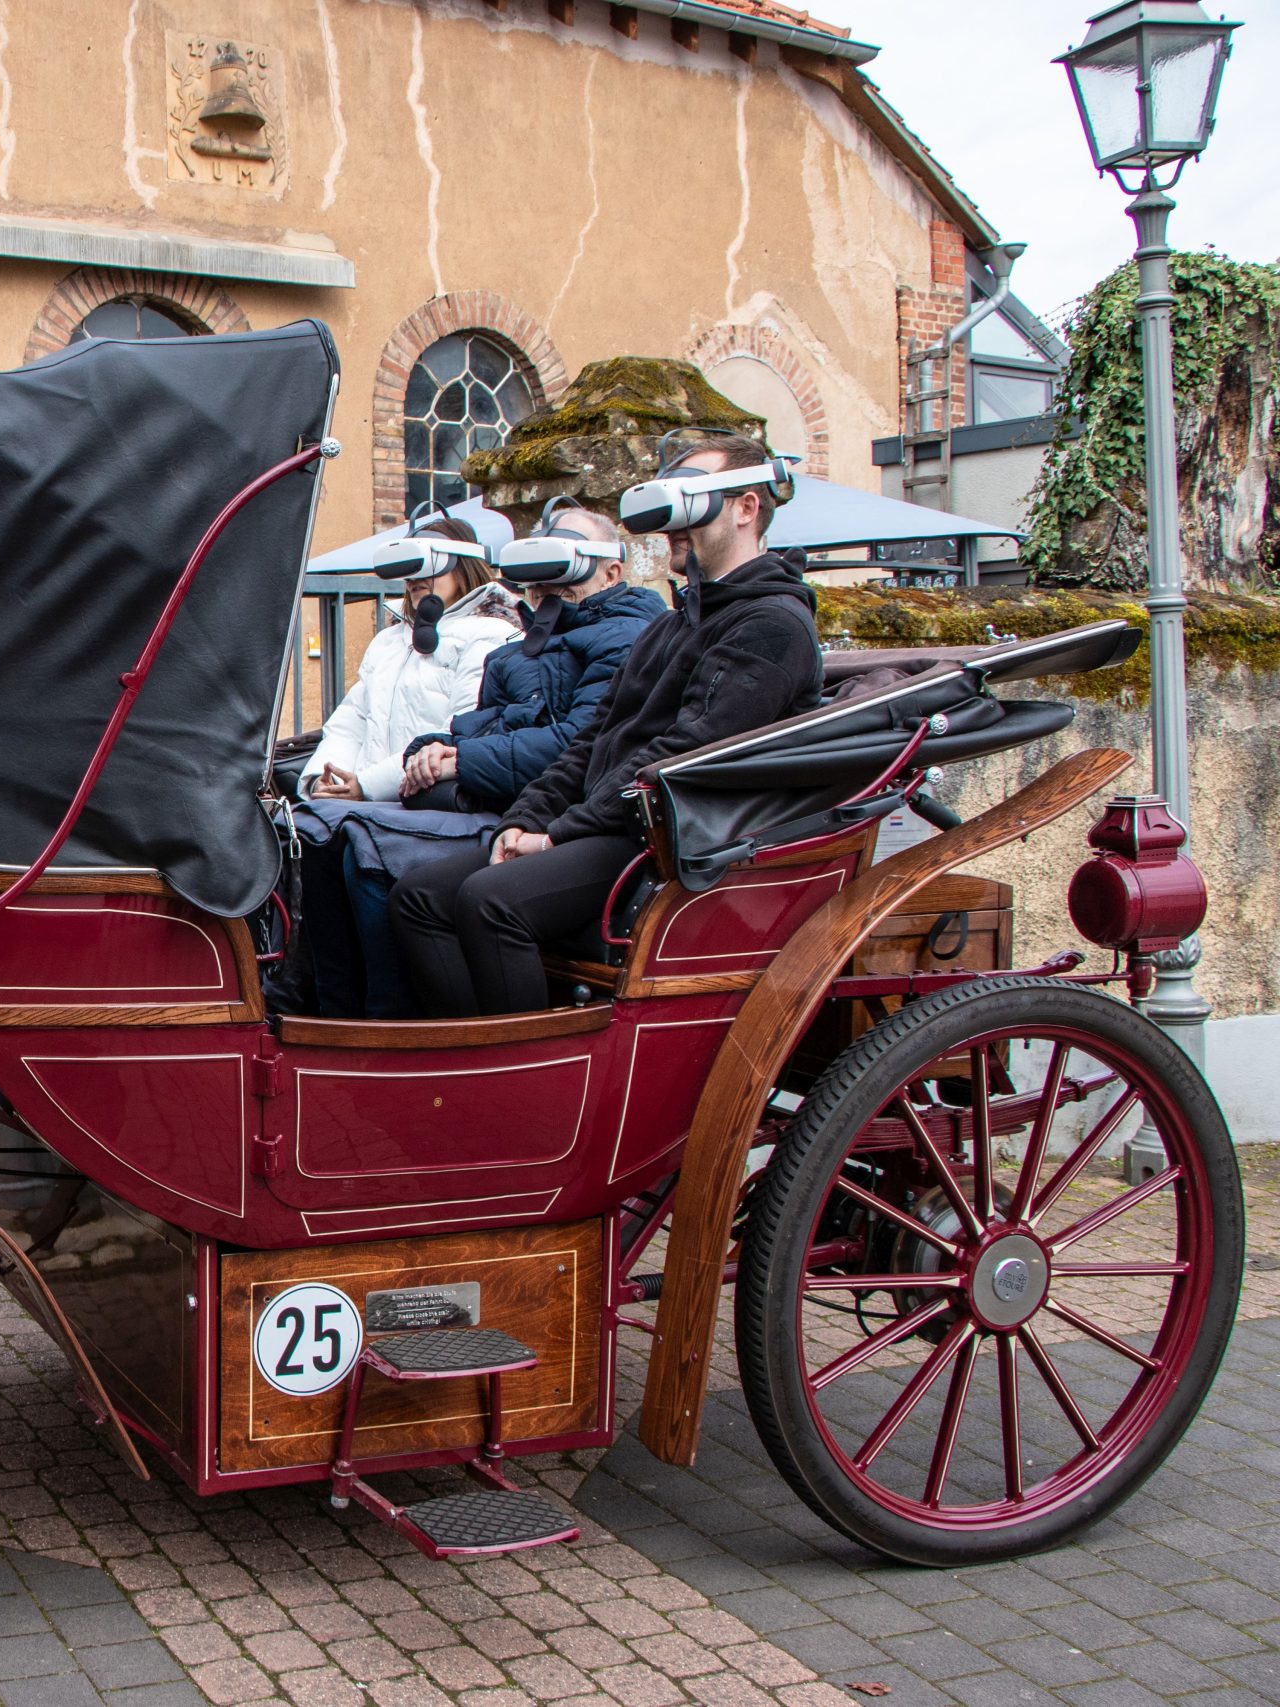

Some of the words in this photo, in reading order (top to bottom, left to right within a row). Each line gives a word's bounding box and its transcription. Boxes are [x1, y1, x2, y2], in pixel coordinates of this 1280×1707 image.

[188, 41, 207, 58] 17
[246, 48, 268, 68] 70
[237, 164, 253, 186] M
[275, 1303, 342, 1377] 25
